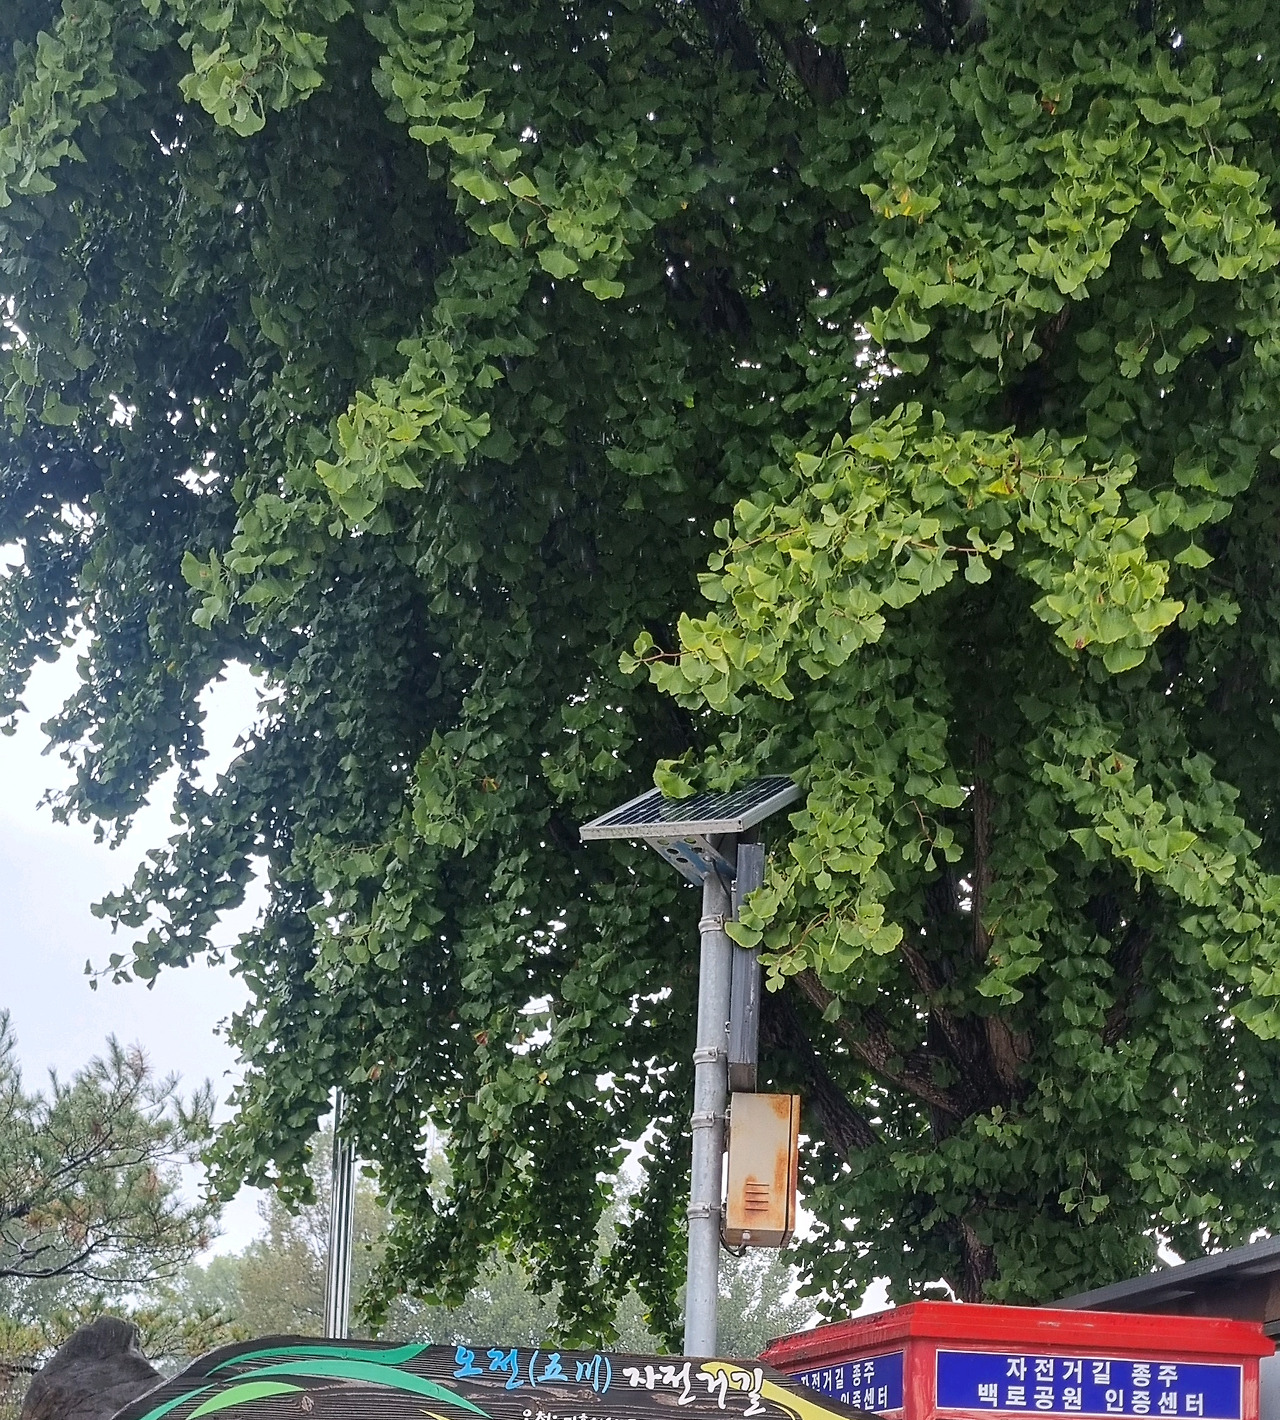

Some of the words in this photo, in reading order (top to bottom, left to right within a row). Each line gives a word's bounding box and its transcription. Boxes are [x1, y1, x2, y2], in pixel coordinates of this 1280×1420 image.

[622, 1361, 766, 1416] 자전거길
[852, 1361, 875, 1387] 종주
[1006, 1357, 1111, 1385] 자전거길
[1131, 1363, 1178, 1388] 종주
[978, 1383, 1083, 1411] 백로공원
[1105, 1389, 1204, 1416] 인증센터
